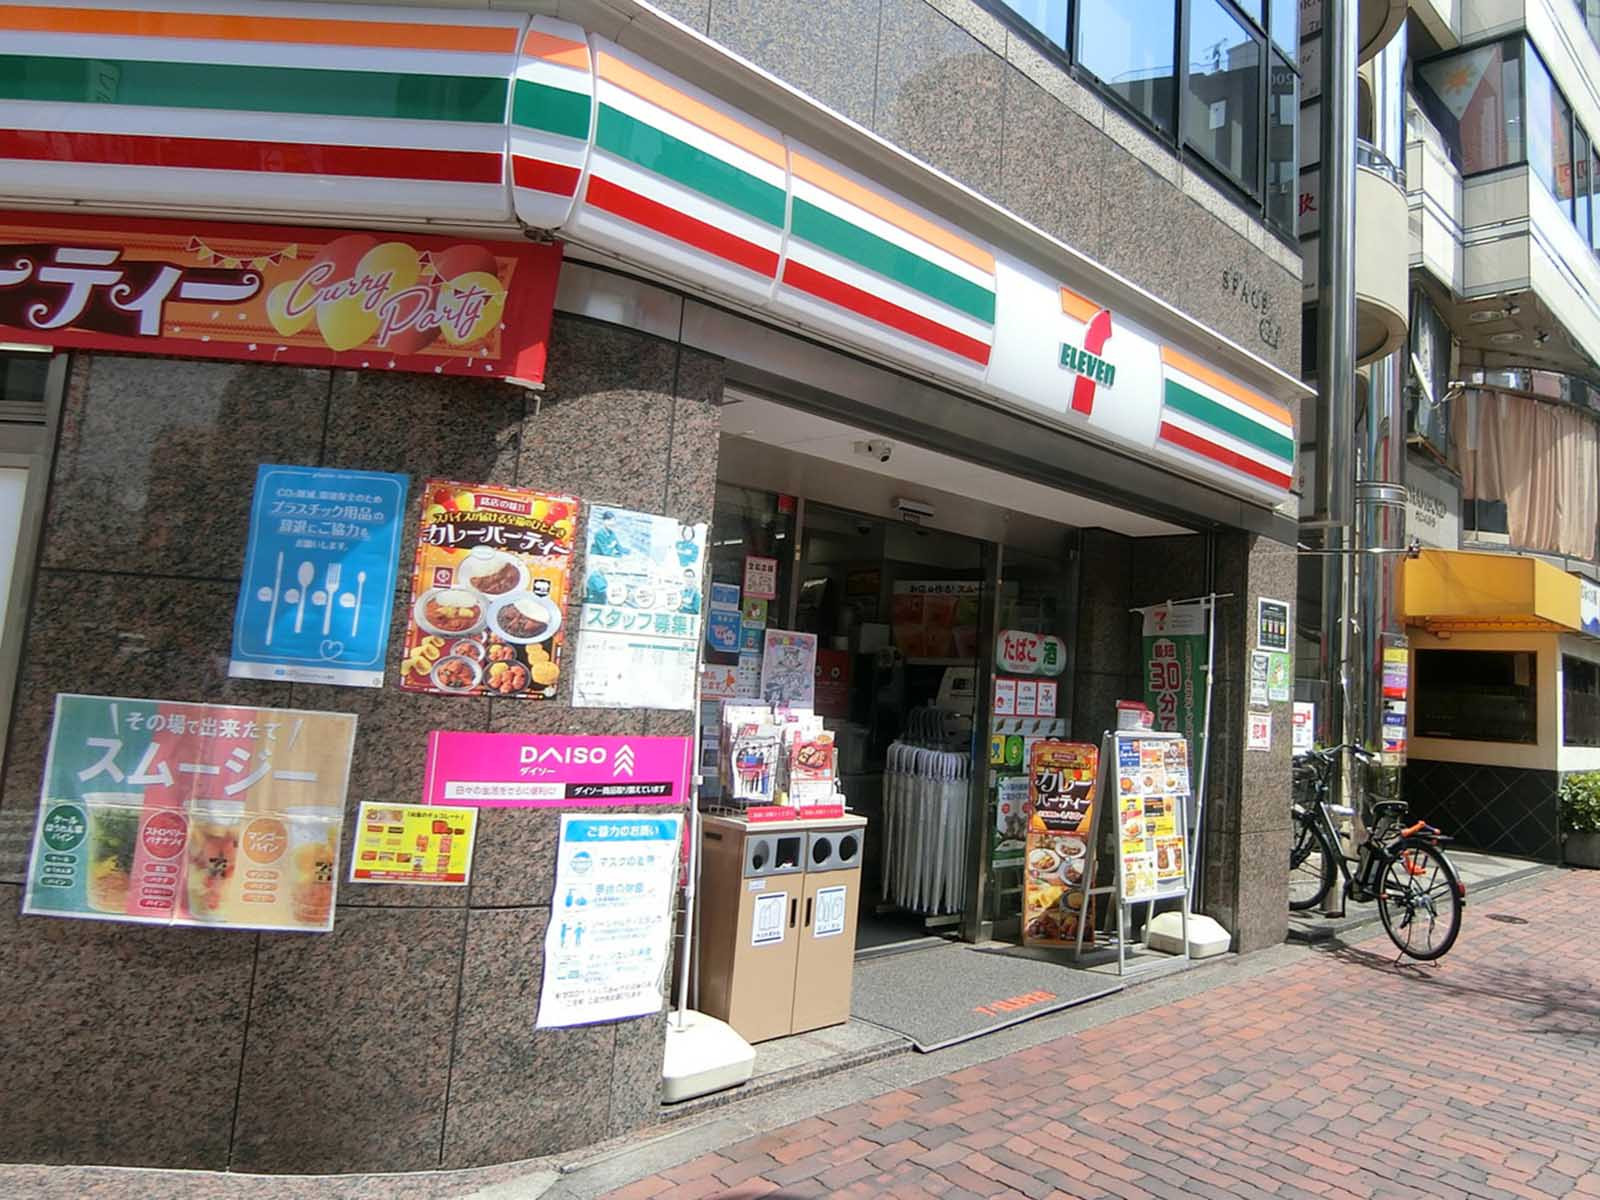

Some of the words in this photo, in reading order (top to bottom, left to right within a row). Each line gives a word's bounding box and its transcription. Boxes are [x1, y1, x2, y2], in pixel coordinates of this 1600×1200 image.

[286, 262, 394, 318] Curry
[1222, 268, 1271, 316] SPACE
[378, 285, 487, 348] Party
[1059, 341, 1116, 386] ELEVEN
[423, 523, 571, 556] カレーパーティー
[1003, 634, 1038, 664] たばこ
[125, 711, 282, 741] その場で出来たて
[77, 737, 319, 796] スムージー
[520, 745, 607, 764] DAISO
[520, 766, 557, 776] ダイソー
[1034, 768, 1093, 792] カレー
[1034, 793, 1091, 811] パーティー
